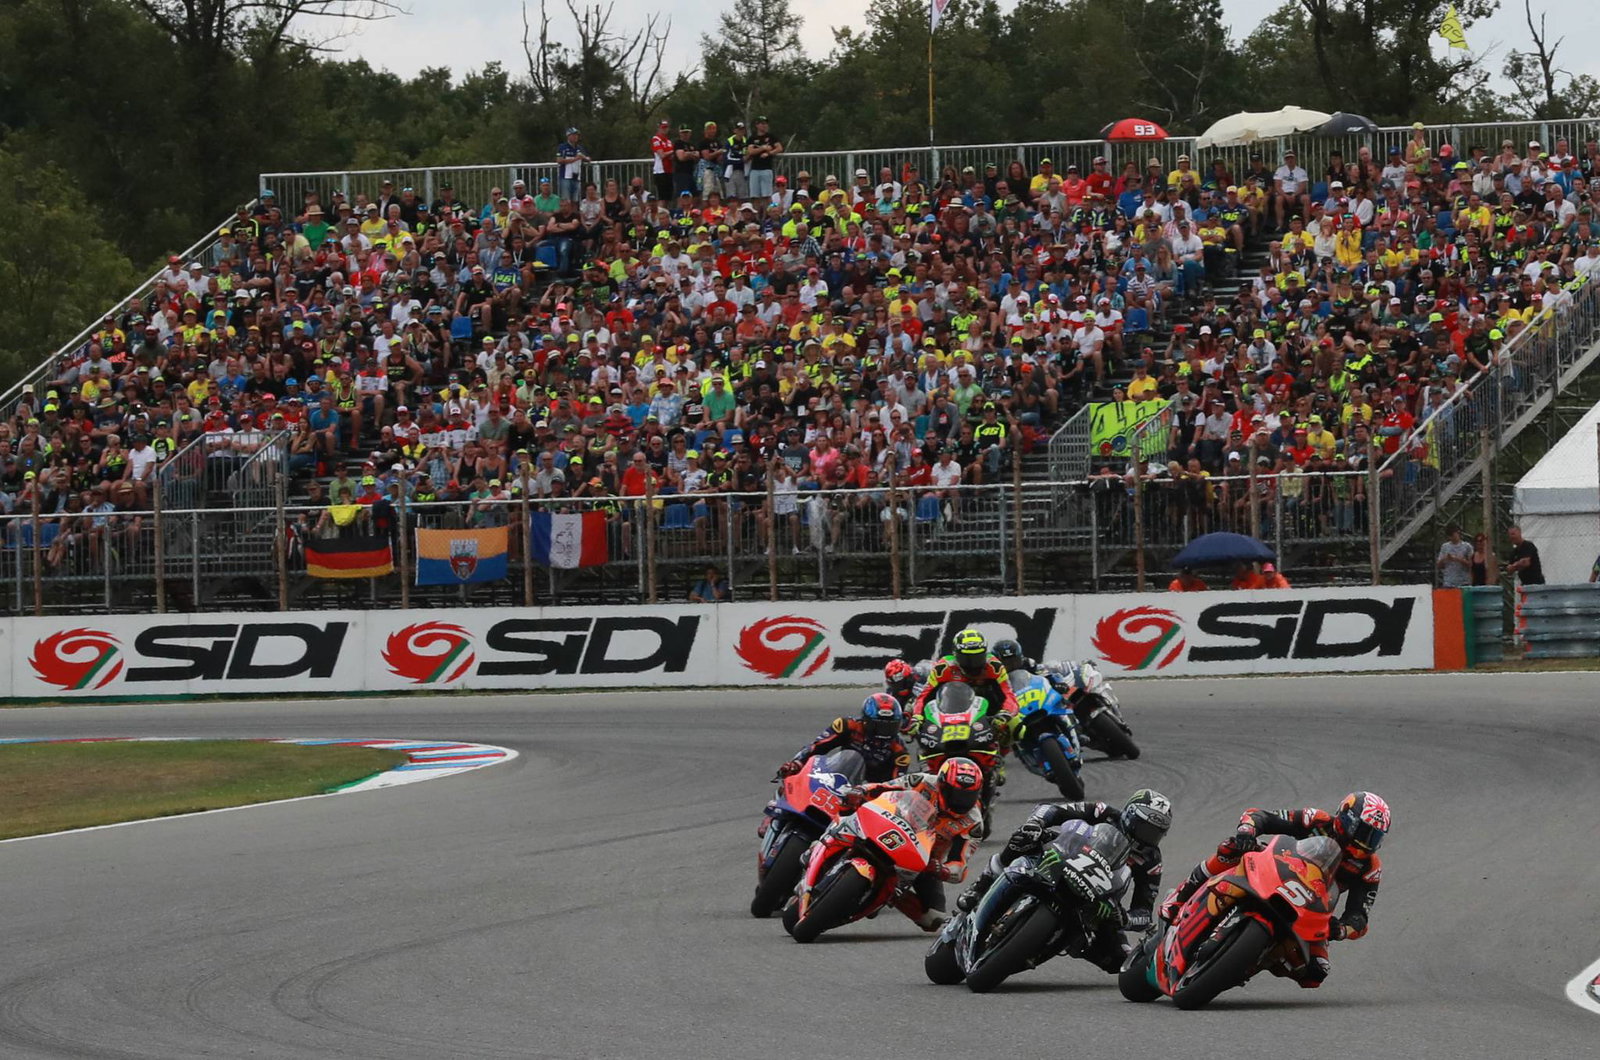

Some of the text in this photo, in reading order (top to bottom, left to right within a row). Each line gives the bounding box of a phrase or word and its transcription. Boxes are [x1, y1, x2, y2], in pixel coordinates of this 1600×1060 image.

[1134, 125, 1156, 136] 93
[980, 427, 1000, 436] 46
[1187, 597, 1416, 662] SIDI
[124, 622, 348, 682] SIDI
[475, 616, 701, 677] SIDI
[941, 725, 970, 743] 29
[1066, 853, 1113, 891] 12
[1089, 849, 1115, 879] ENEOS
[1062, 866, 1096, 902] MONSTER
[1276, 880, 1313, 907] 5
